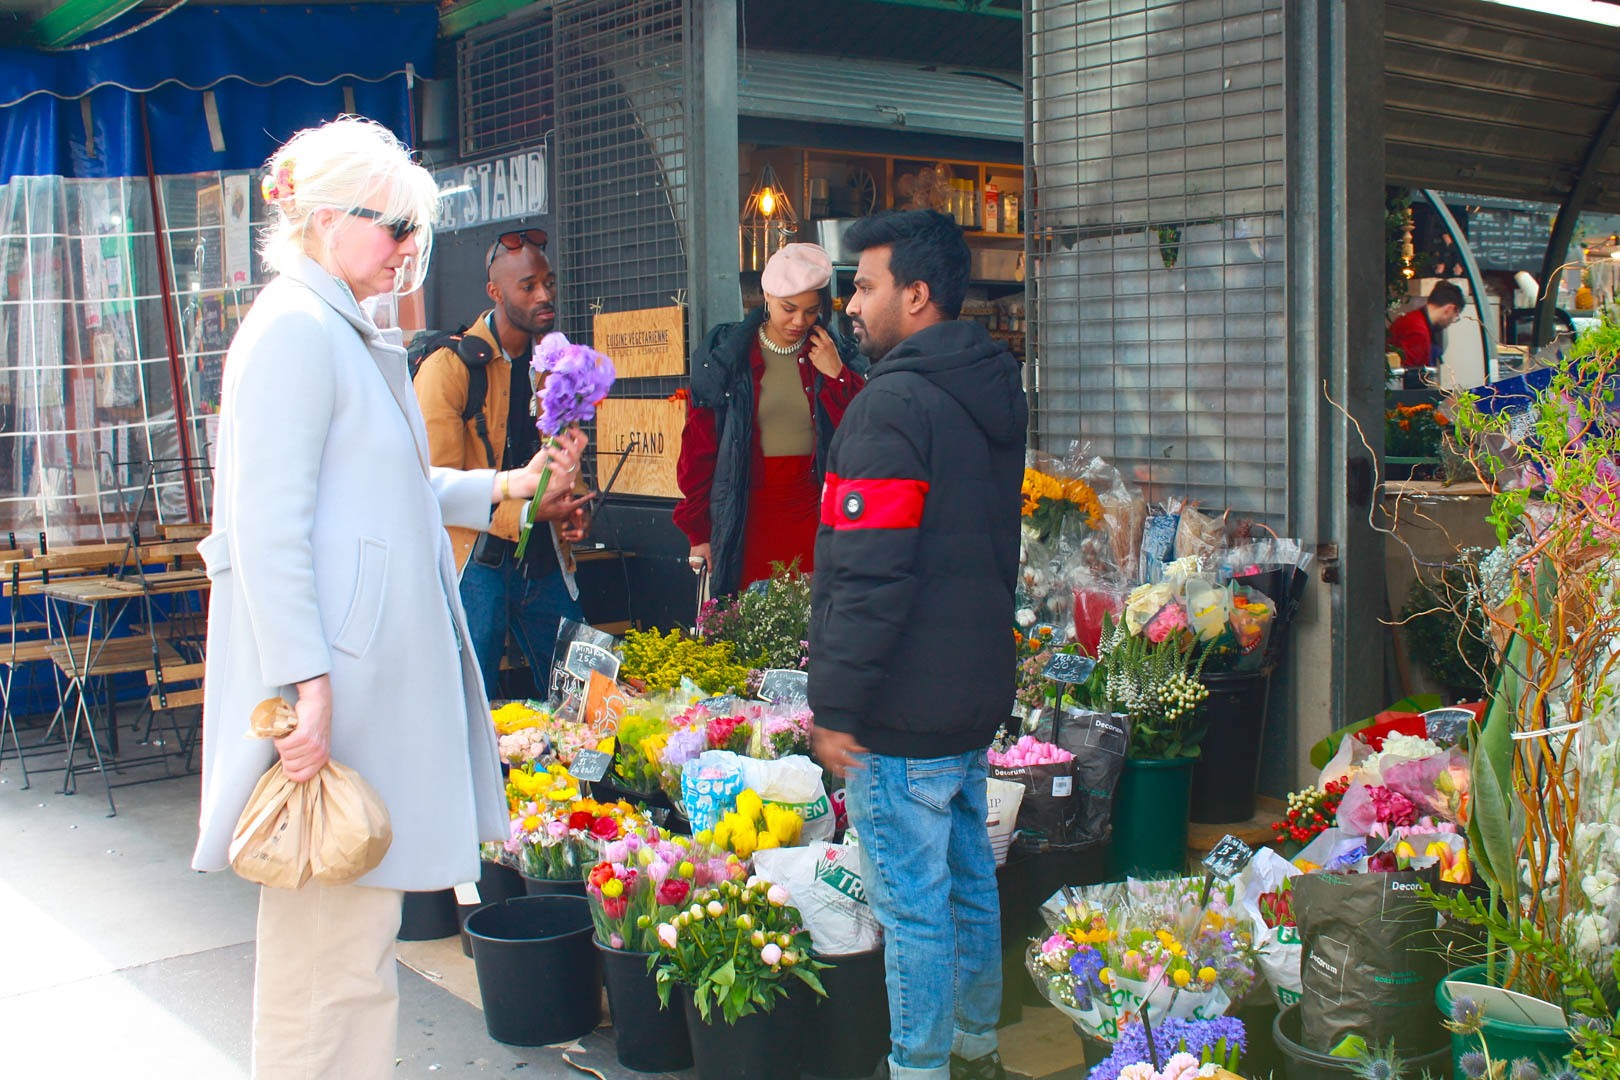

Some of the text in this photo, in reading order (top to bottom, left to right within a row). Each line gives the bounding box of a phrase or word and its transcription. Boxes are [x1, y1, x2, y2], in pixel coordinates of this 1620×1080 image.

[463, 152, 546, 224] STAND
[606, 333, 628, 347] CUISINE
[615, 431, 664, 454] LE STAND
[994, 768, 1026, 777] Decorum
[988, 798, 1002, 809] IP
[839, 869, 867, 900] TR
